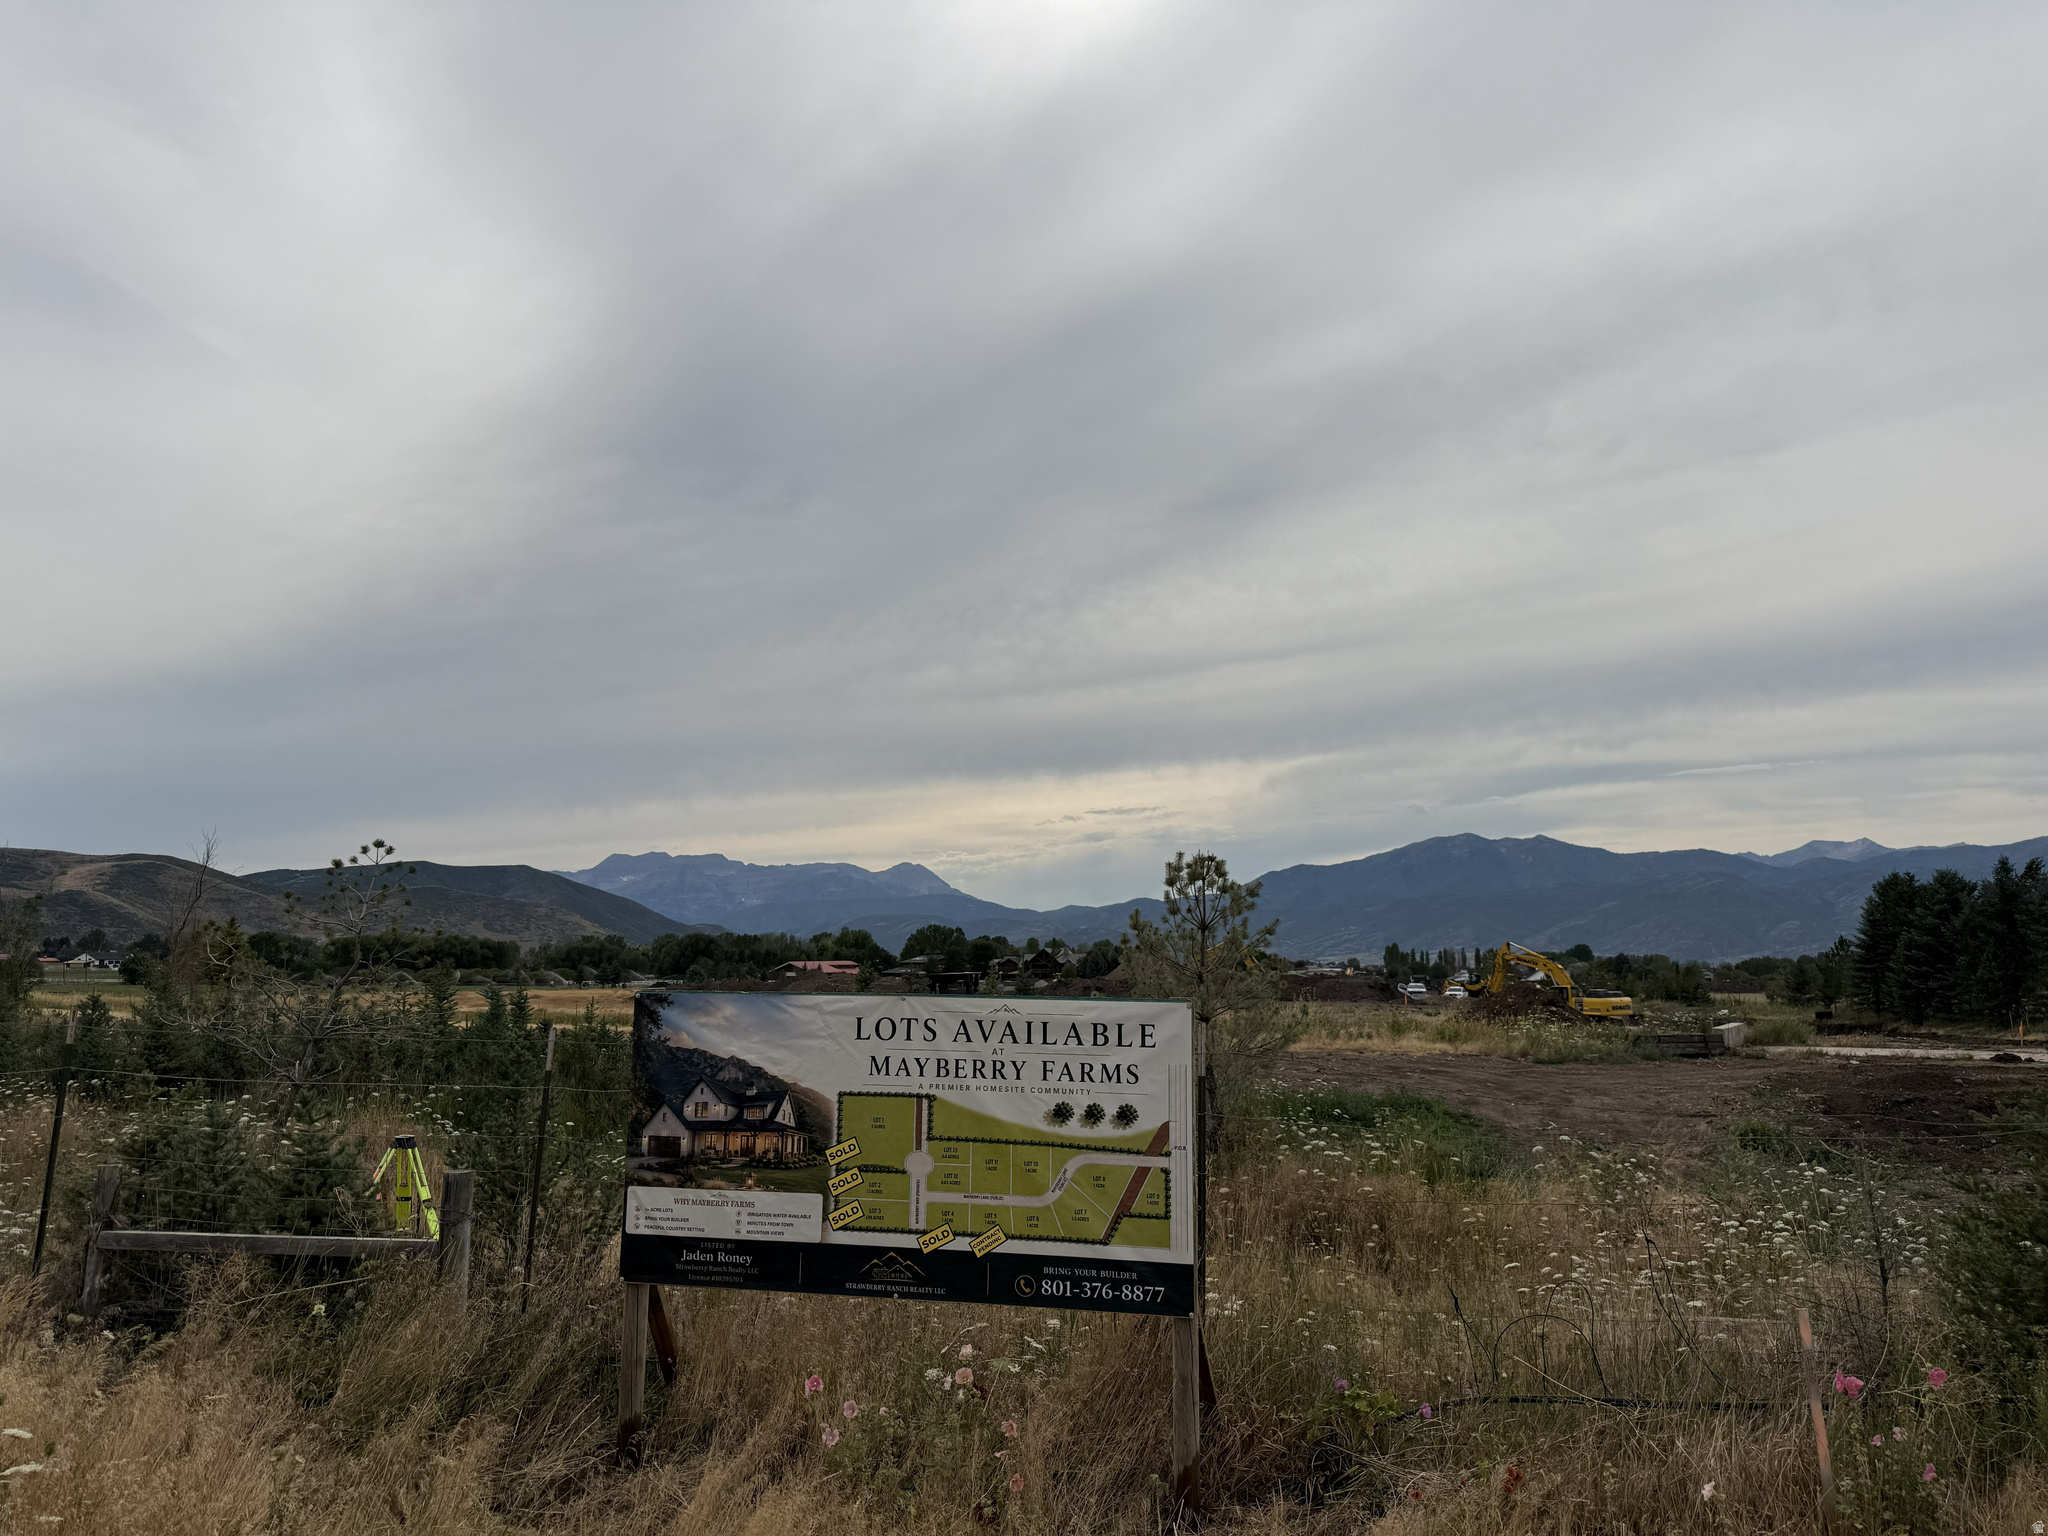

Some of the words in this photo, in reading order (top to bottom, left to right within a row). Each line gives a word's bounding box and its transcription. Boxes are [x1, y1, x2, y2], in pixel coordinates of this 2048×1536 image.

[854, 1016, 937, 1042] LOTS
[952, 1019, 1157, 1048] AVAILABLE
[868, 1056, 1027, 1080] MAYBERRY
[1041, 1060, 1140, 1085] FARMS
[976, 1085, 1026, 1093] HOMESITE
[1030, 1086, 1092, 1095] COMMUNITY
[828, 1144, 856, 1160] SOLD
[831, 1173, 858, 1191] SOLD
[692, 1199, 729, 1207] MAYBERRY
[832, 1206, 859, 1224] SOLD
[922, 1230, 950, 1249] SOLD
[972, 1228, 1001, 1249] CONTRACT
[978, 1236, 1002, 1253] PENDING
[681, 1250, 714, 1261] Jaden
[718, 1252, 752, 1266] Roney
[675, 1263, 708, 1272] Strawberry
[1043, 1266, 1071, 1275] BRING
[1074, 1269, 1097, 1277] YOUR
[1100, 1270, 1138, 1280] BUILDER
[845, 1282, 886, 1291] STRAWBERRY
[1041, 1279, 1165, 1302] 801-376-8877
